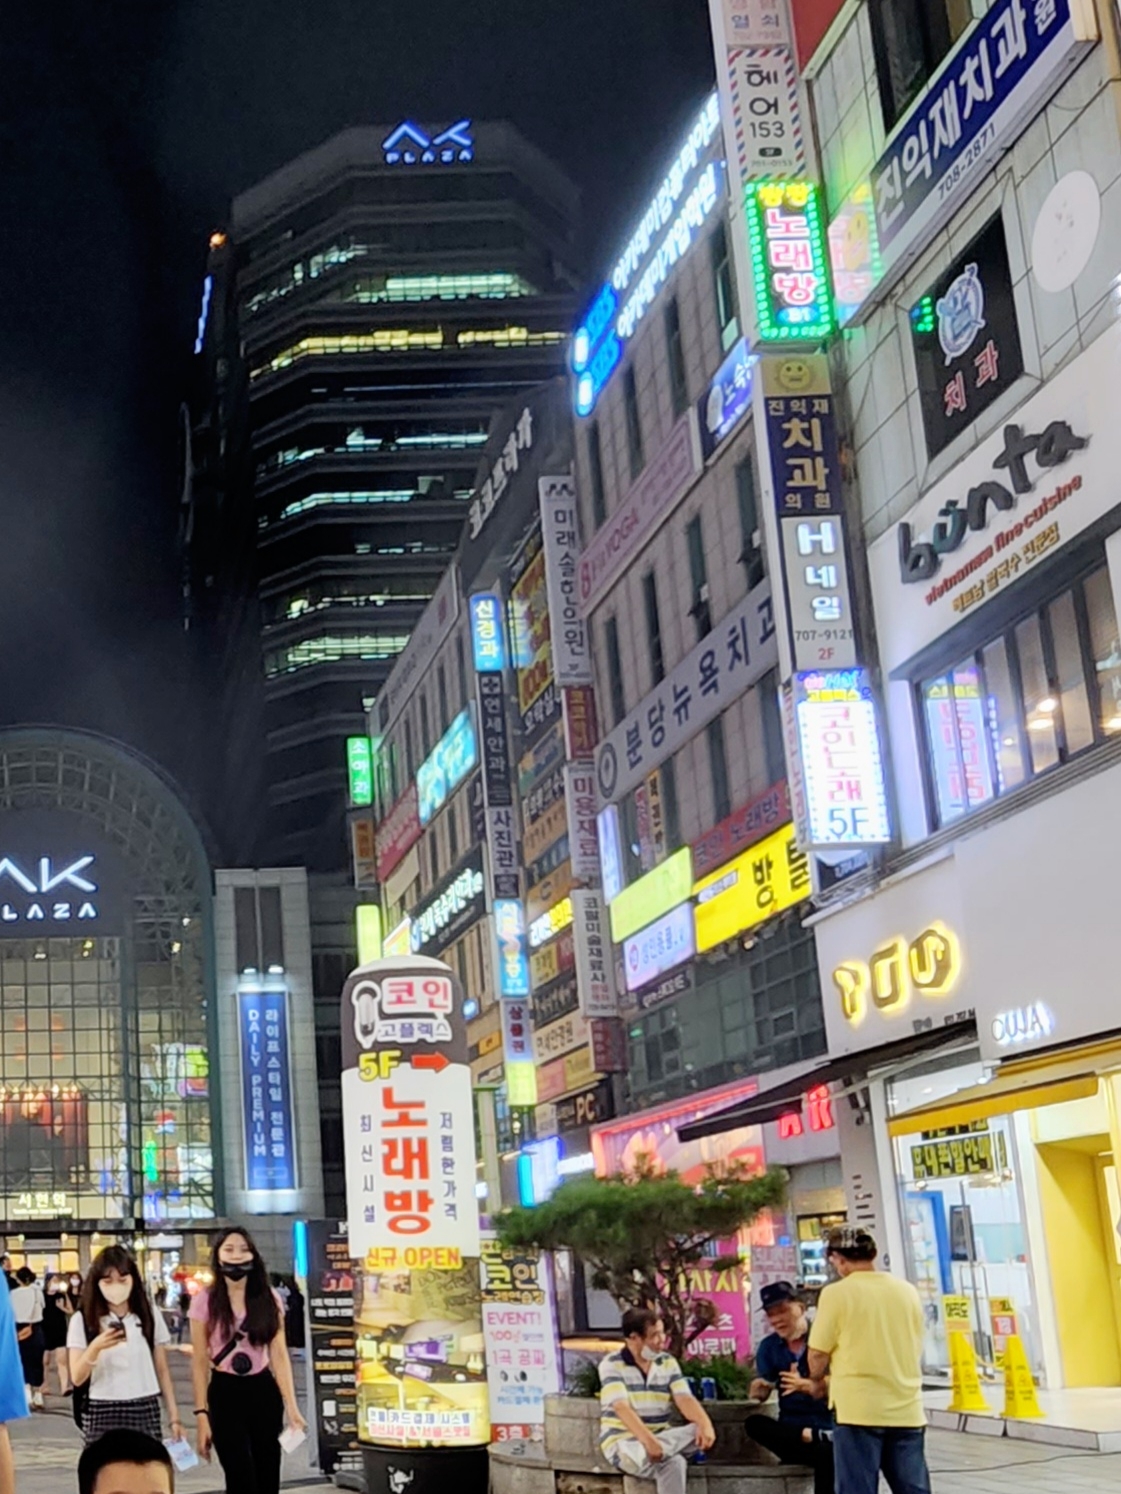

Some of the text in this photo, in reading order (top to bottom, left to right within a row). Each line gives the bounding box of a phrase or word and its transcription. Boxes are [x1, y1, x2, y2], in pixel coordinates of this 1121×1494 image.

[745, 64, 778, 115] 헤어
[750, 122, 785, 138] 153
[937, 122, 996, 197] 708-2871
[766, 208, 816, 306] 노래방
[783, 418, 830, 490] 치과
[795, 629, 854, 642] 707-9121
[819, 648, 834, 660] 2F
[386, 980, 449, 1009] 코인
[381, 1021, 451, 1040] 고플렉스
[359, 1051, 400, 1082] 5F
[247, 1008, 267, 1158] DAILY PREMIUM
[381, 1086, 435, 1235] 노래방
[18, 1190, 66, 1209] 서현역
[367, 1247, 462, 1268] 신규 OPEN
[487, 1311, 542, 1326] EVENT!
